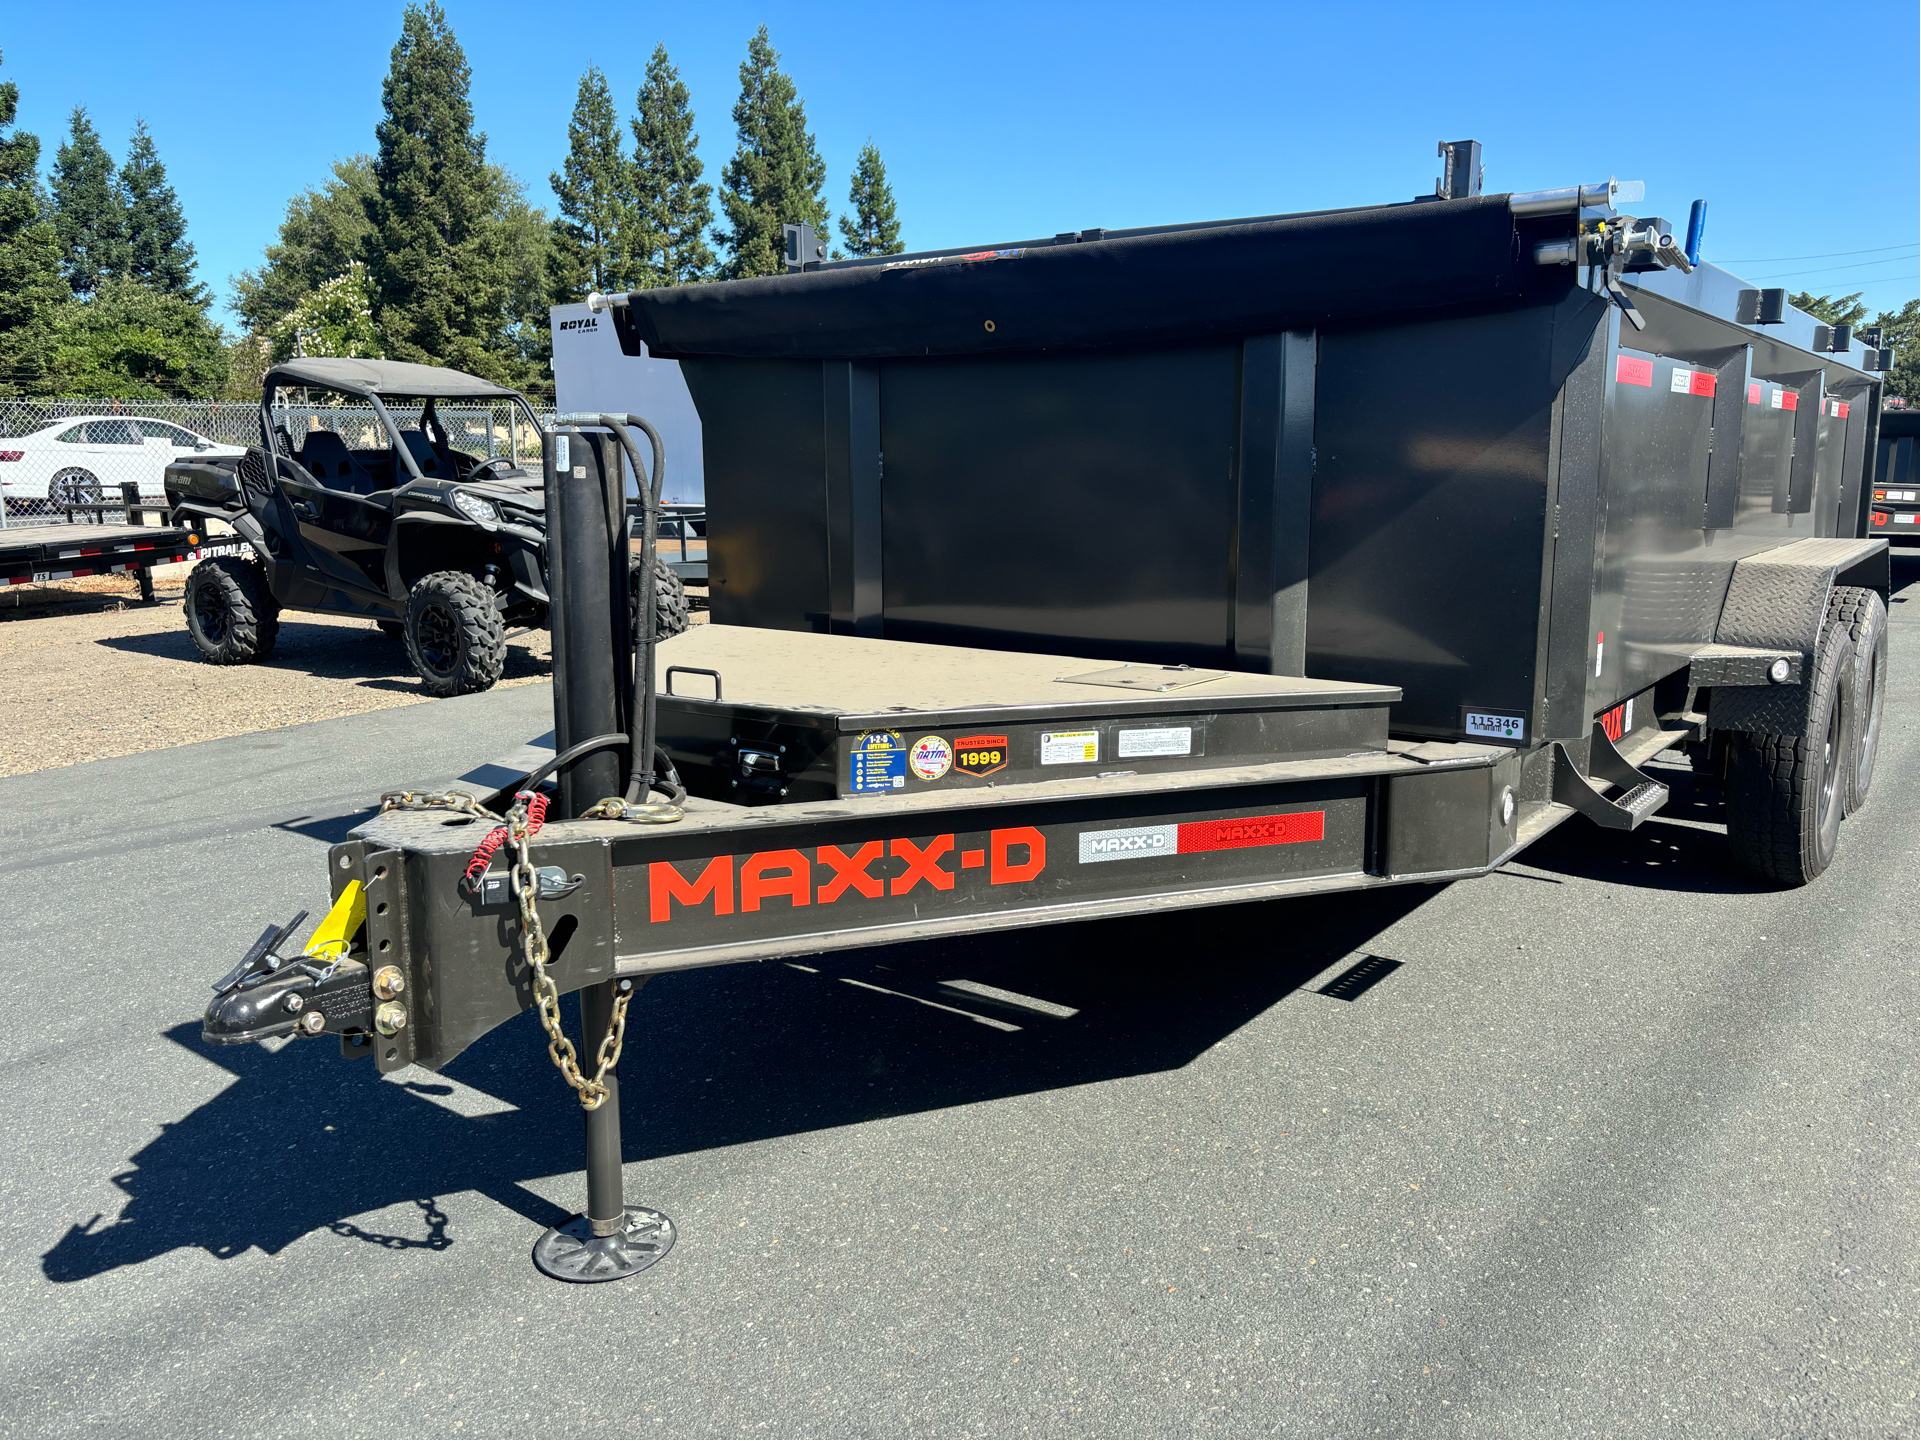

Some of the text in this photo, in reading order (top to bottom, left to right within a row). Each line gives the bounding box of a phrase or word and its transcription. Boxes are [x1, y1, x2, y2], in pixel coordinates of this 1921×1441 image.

[560, 318, 598, 330] ROYAL
[168, 474, 192, 486] can-am
[200, 547, 211, 558] PJ
[1470, 716, 1519, 729] 115346
[960, 751, 1001, 766] 1999
[1216, 823, 1286, 841] MAXX-D
[1092, 834, 1165, 853] MAXX-D
[649, 826, 1046, 923] MAXX-D
